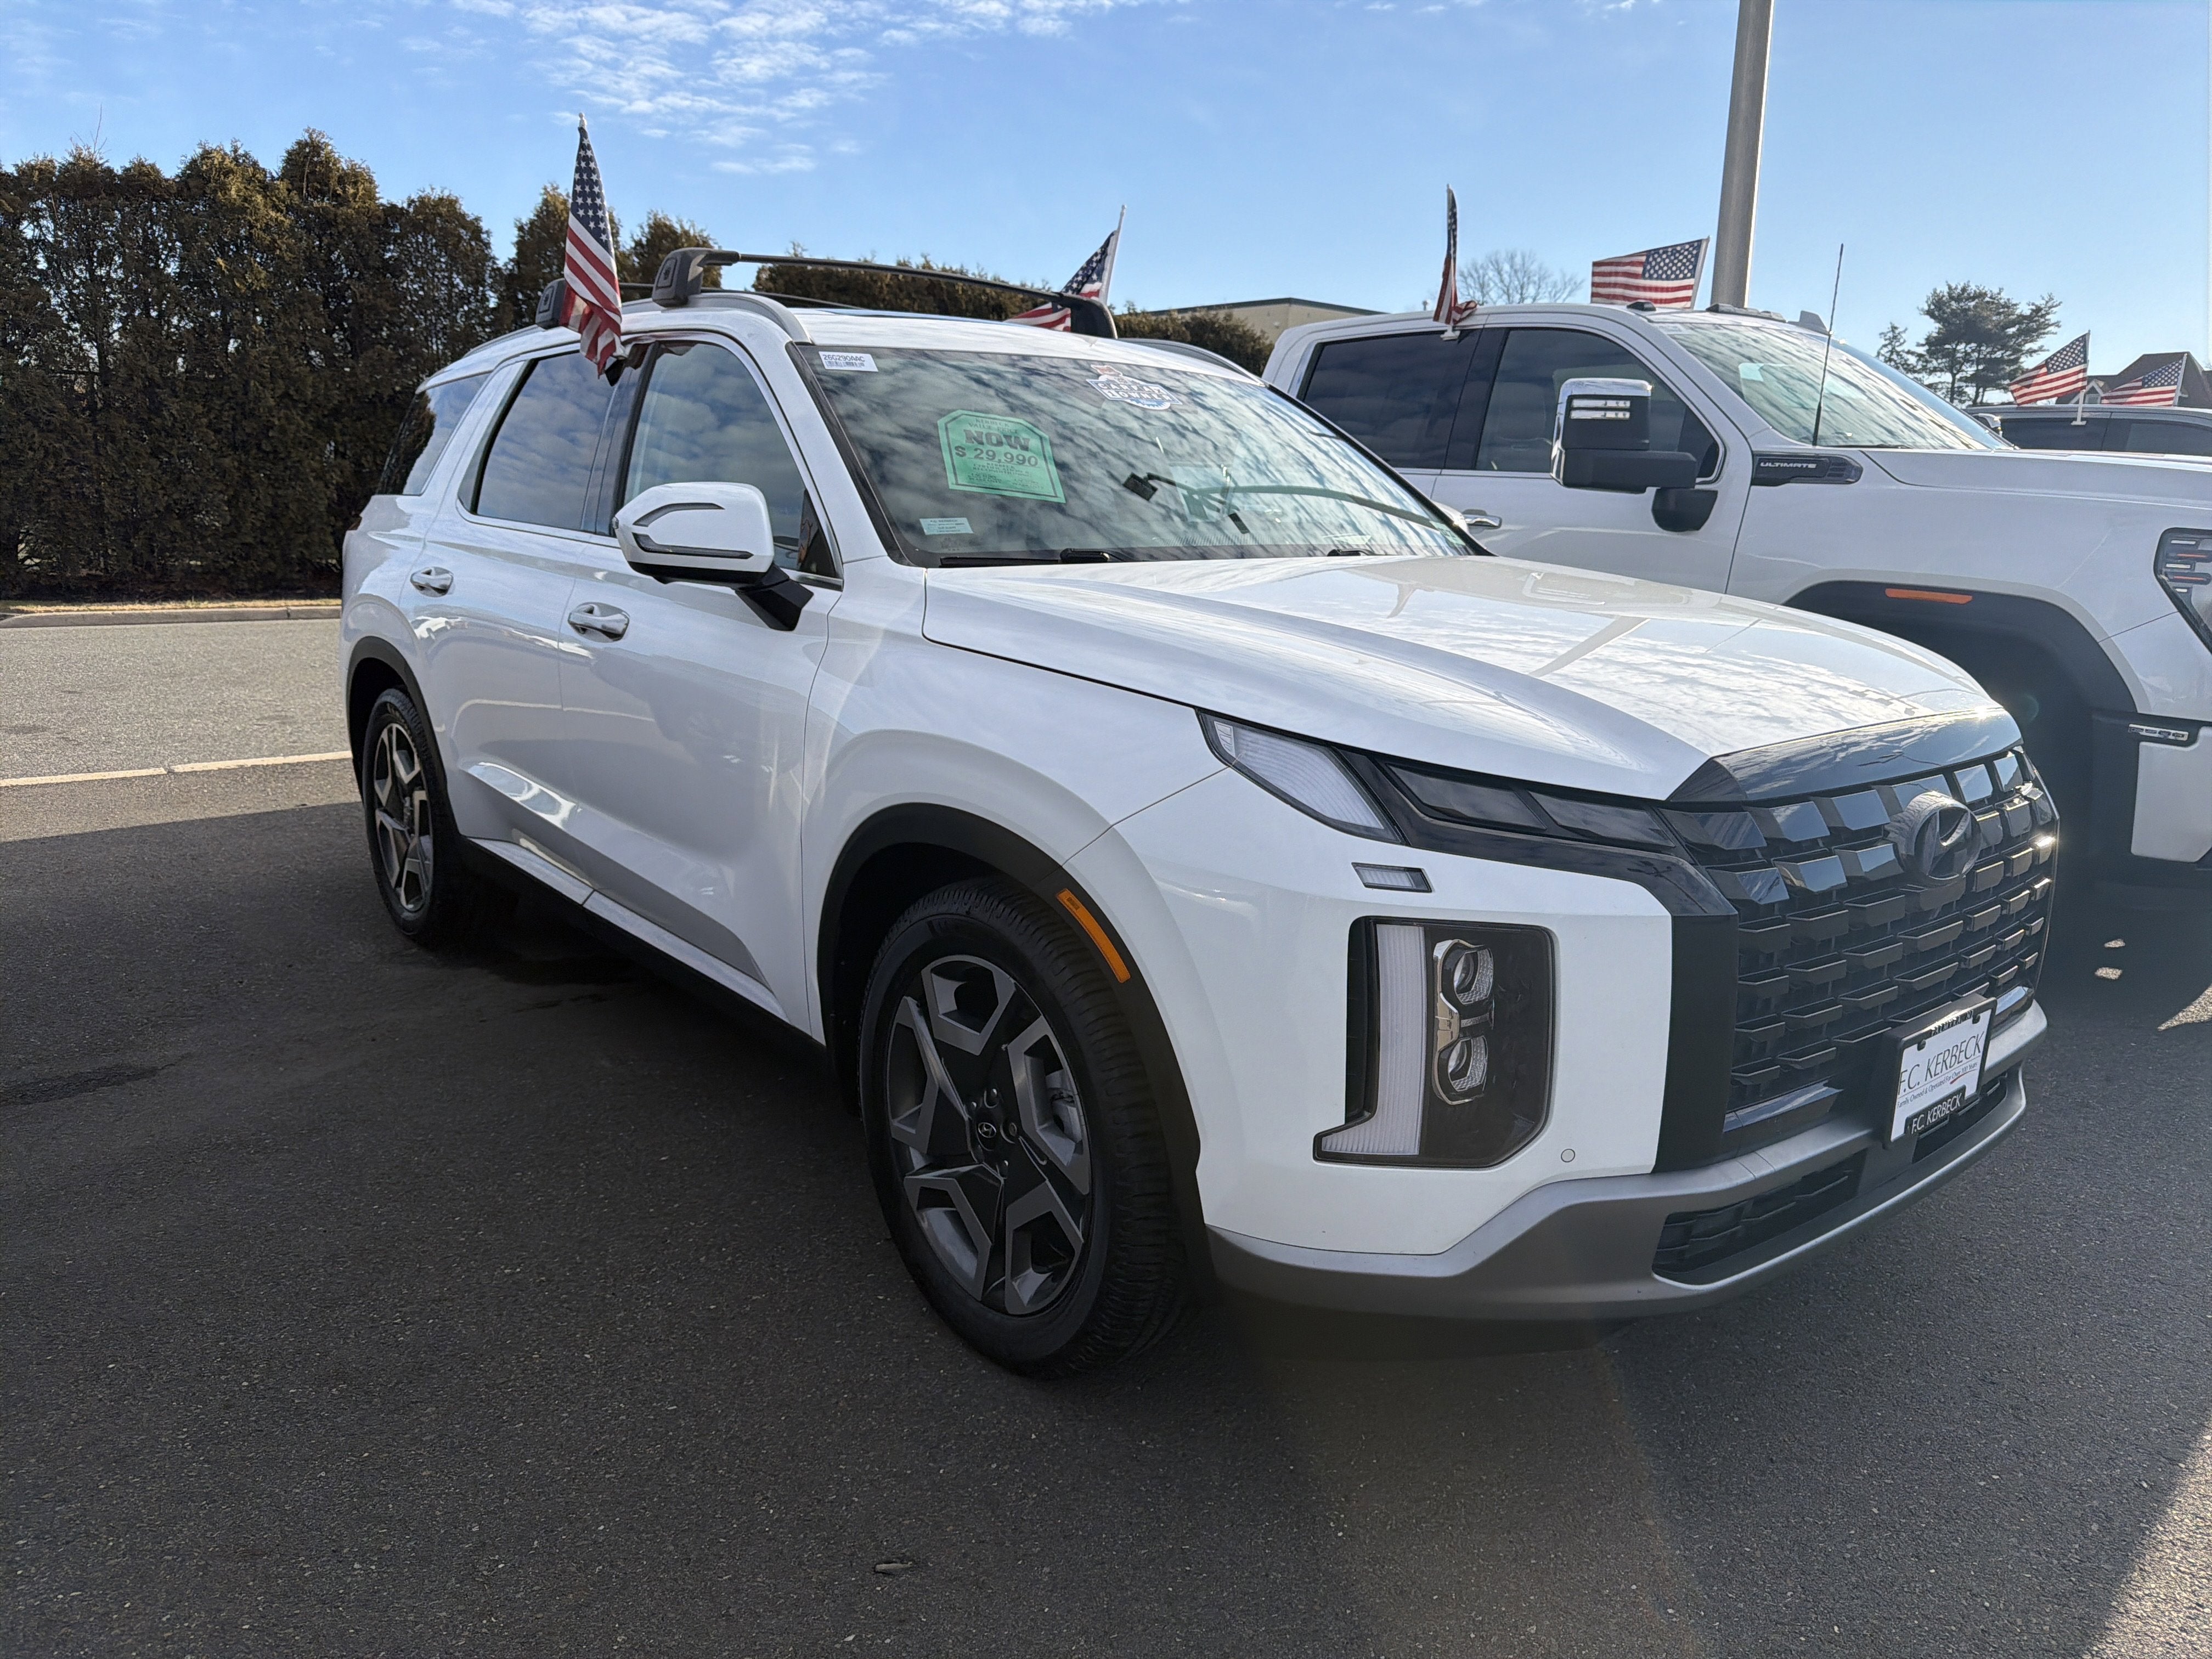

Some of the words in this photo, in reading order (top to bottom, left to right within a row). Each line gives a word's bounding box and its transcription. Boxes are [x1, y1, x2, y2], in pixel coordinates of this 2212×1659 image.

[1119, 391, 1172, 401] OWNER
[955, 445, 967, 457] $
[973, 448, 1039, 467] 29,990
[963, 429, 1030, 452] NOW
[1898, 1064, 1920, 1095] F.C.
[1925, 1031, 1985, 1082] KERBECK
[1897, 1097, 1909, 1109] Family
[1910, 1088, 1925, 1102] Owned
[1928, 1076, 1946, 1092] Operated
[1951, 1070, 1961, 1079] Over
[1968, 1062, 1978, 1070] Years
[1911, 1113, 1925, 1134] F.C.
[1926, 1093, 1962, 1125] KERBECK
